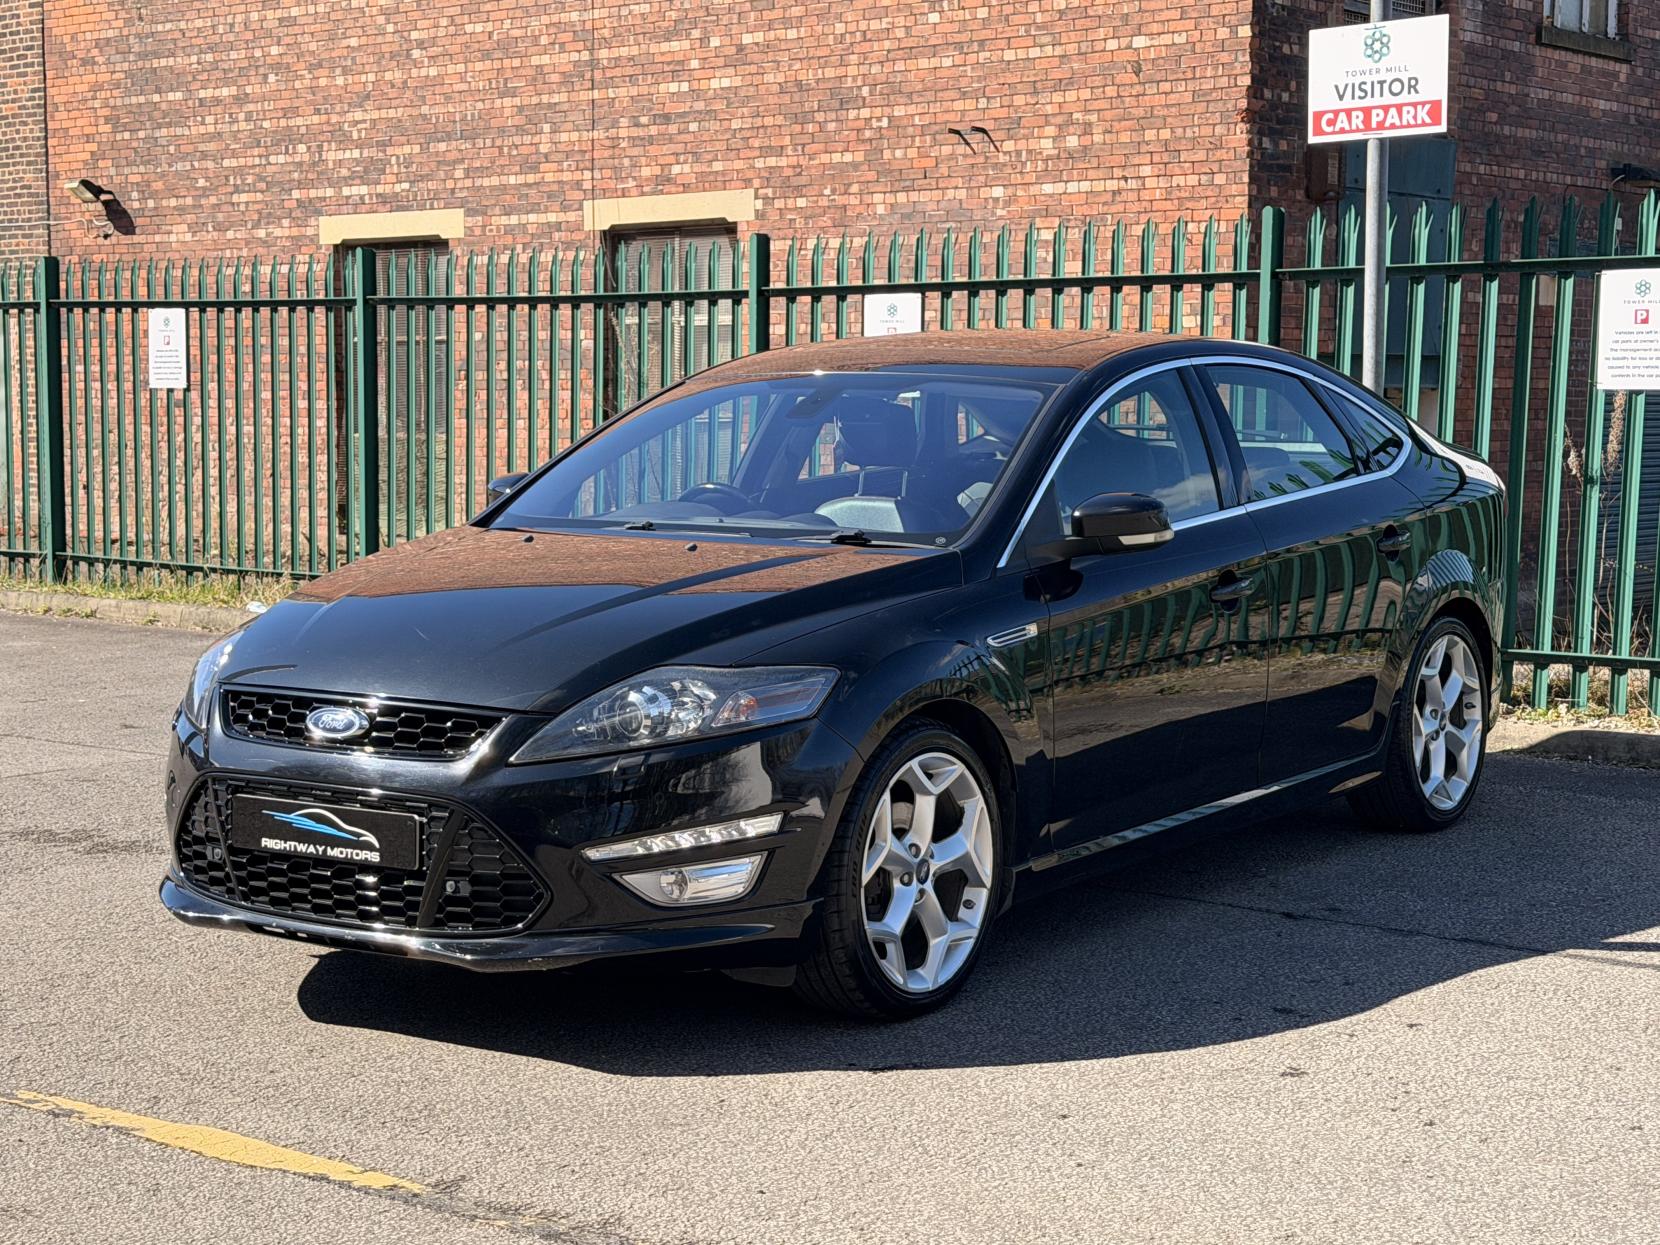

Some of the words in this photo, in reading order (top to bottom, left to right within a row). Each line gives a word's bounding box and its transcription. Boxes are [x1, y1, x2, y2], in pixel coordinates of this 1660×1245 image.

[1345, 68, 1381, 78] TOWER
[1385, 64, 1409, 74] MILL
[1334, 76, 1419, 101] VISITOR
[1320, 110, 1365, 133] CAR
[1371, 103, 1432, 129] PARK
[318, 713, 348, 730] Ford
[261, 837, 325, 855] RIGHTWAY
[327, 847, 380, 862] MOTORS
